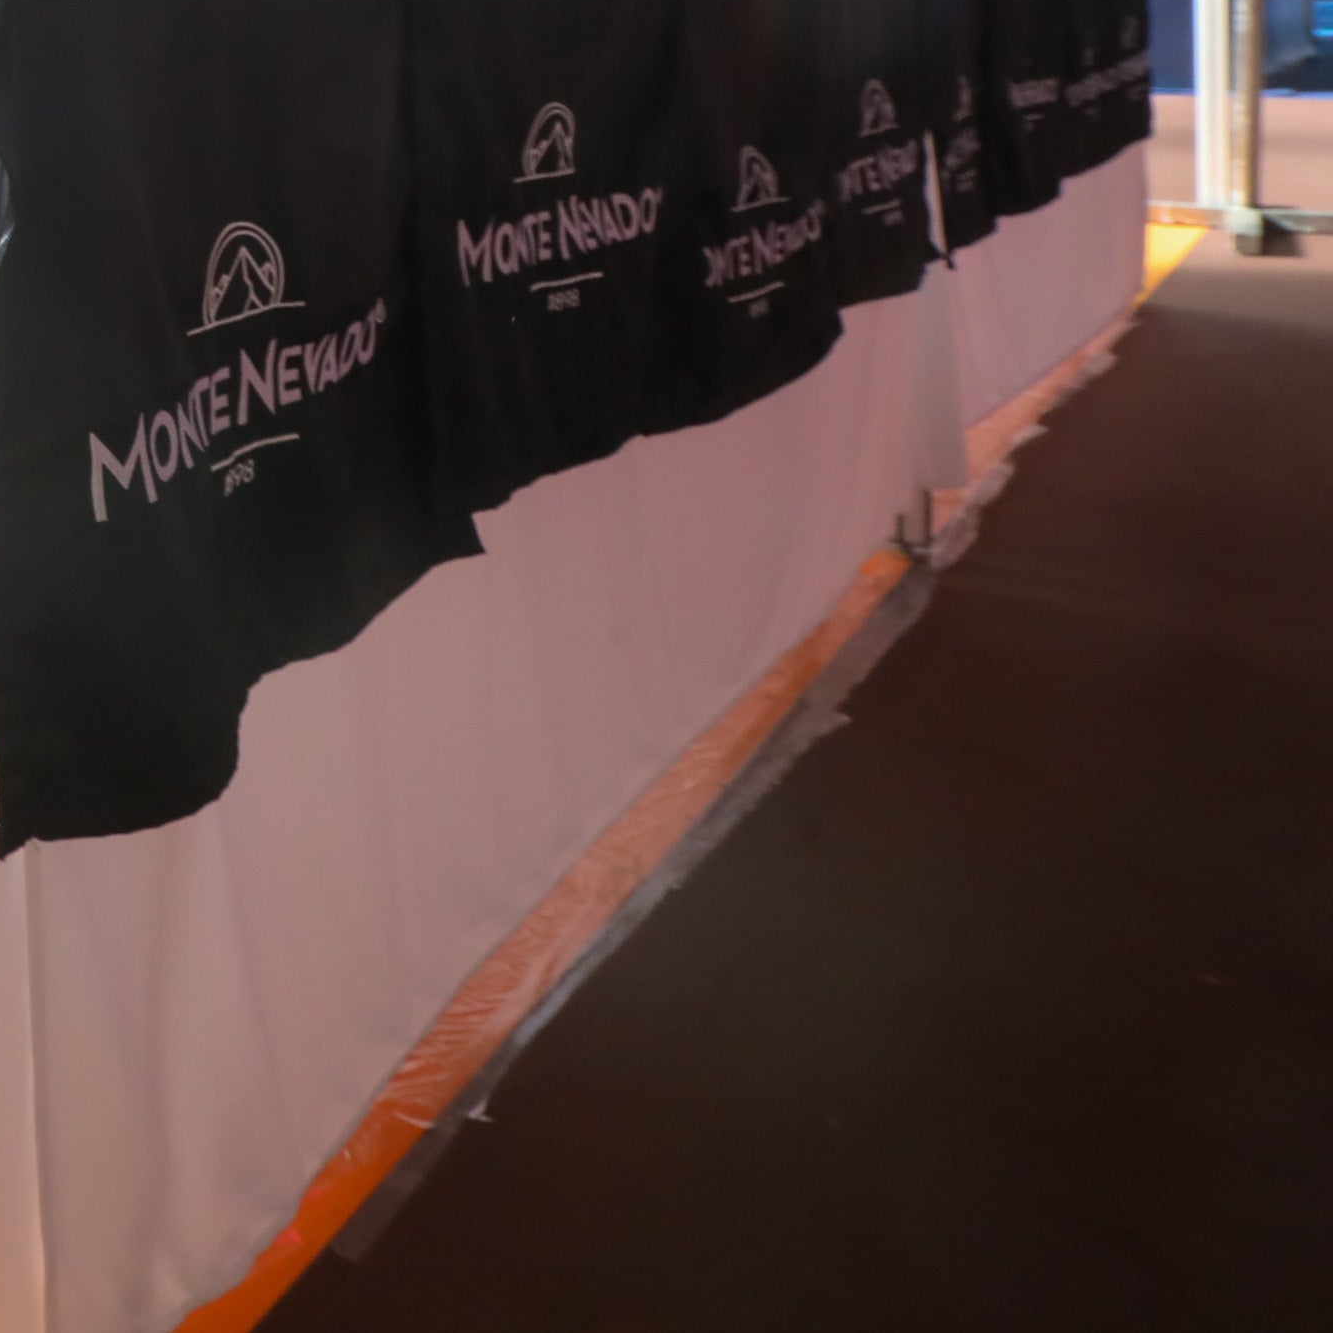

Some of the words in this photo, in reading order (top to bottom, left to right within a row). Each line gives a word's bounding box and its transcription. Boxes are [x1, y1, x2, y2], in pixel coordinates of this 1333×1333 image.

[456, 211, 552, 288] MONTE
[556, 187, 659, 262] NEVADO
[89, 365, 232, 523] MONTE
[235, 316, 378, 426] NEVADO
